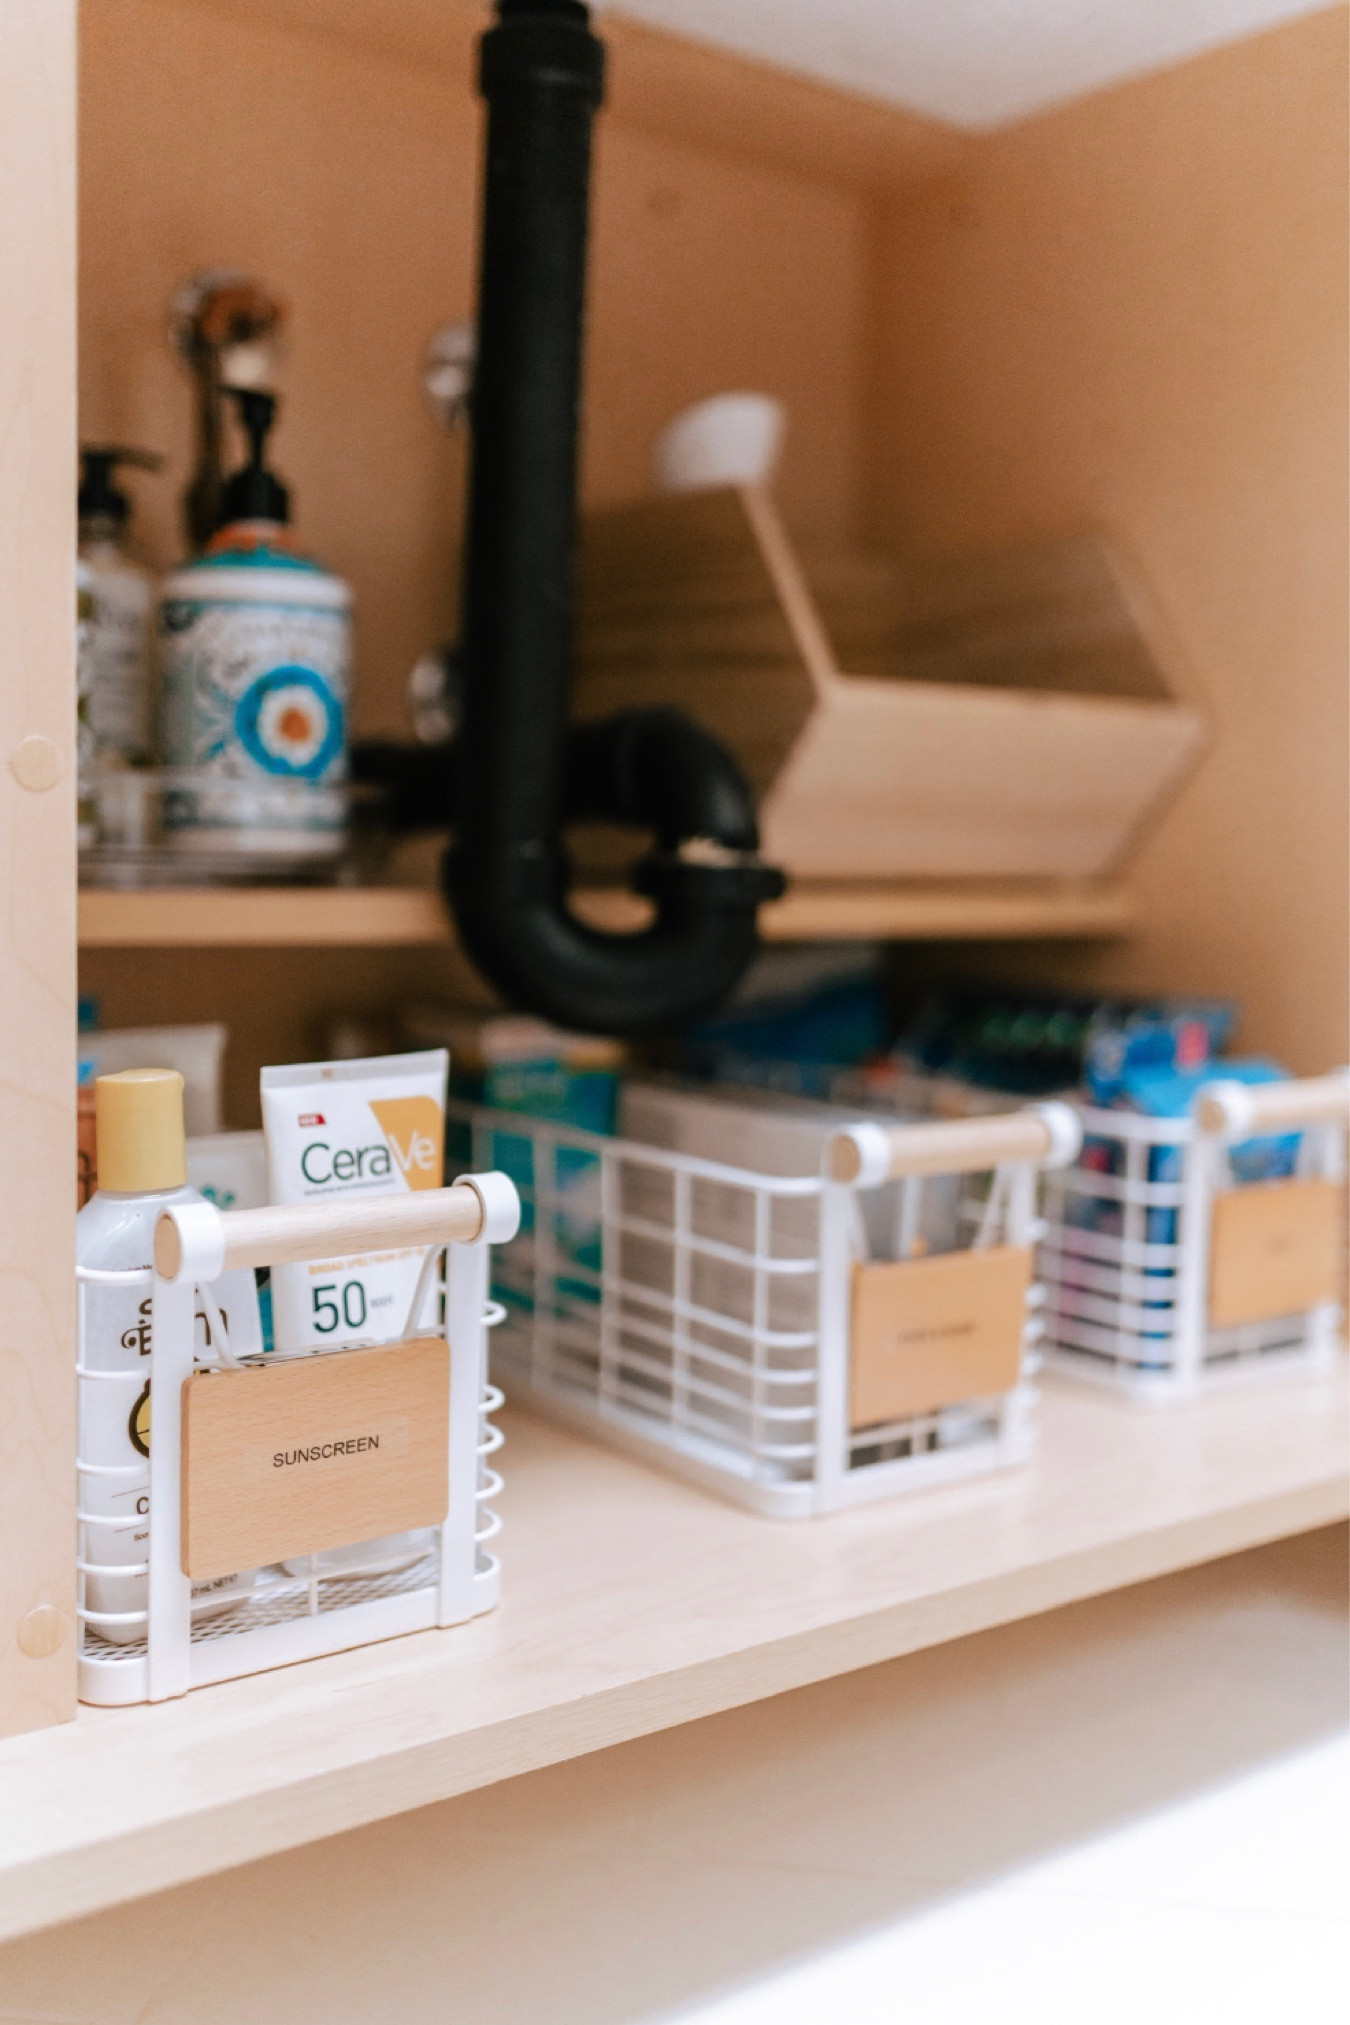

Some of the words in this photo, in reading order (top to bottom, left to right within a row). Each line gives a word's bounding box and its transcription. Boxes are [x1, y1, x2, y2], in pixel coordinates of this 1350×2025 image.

[301, 1130, 436, 1184] CeraVe
[312, 1280, 367, 1333] 50
[273, 1435, 380, 1468] SUNSCREEN
